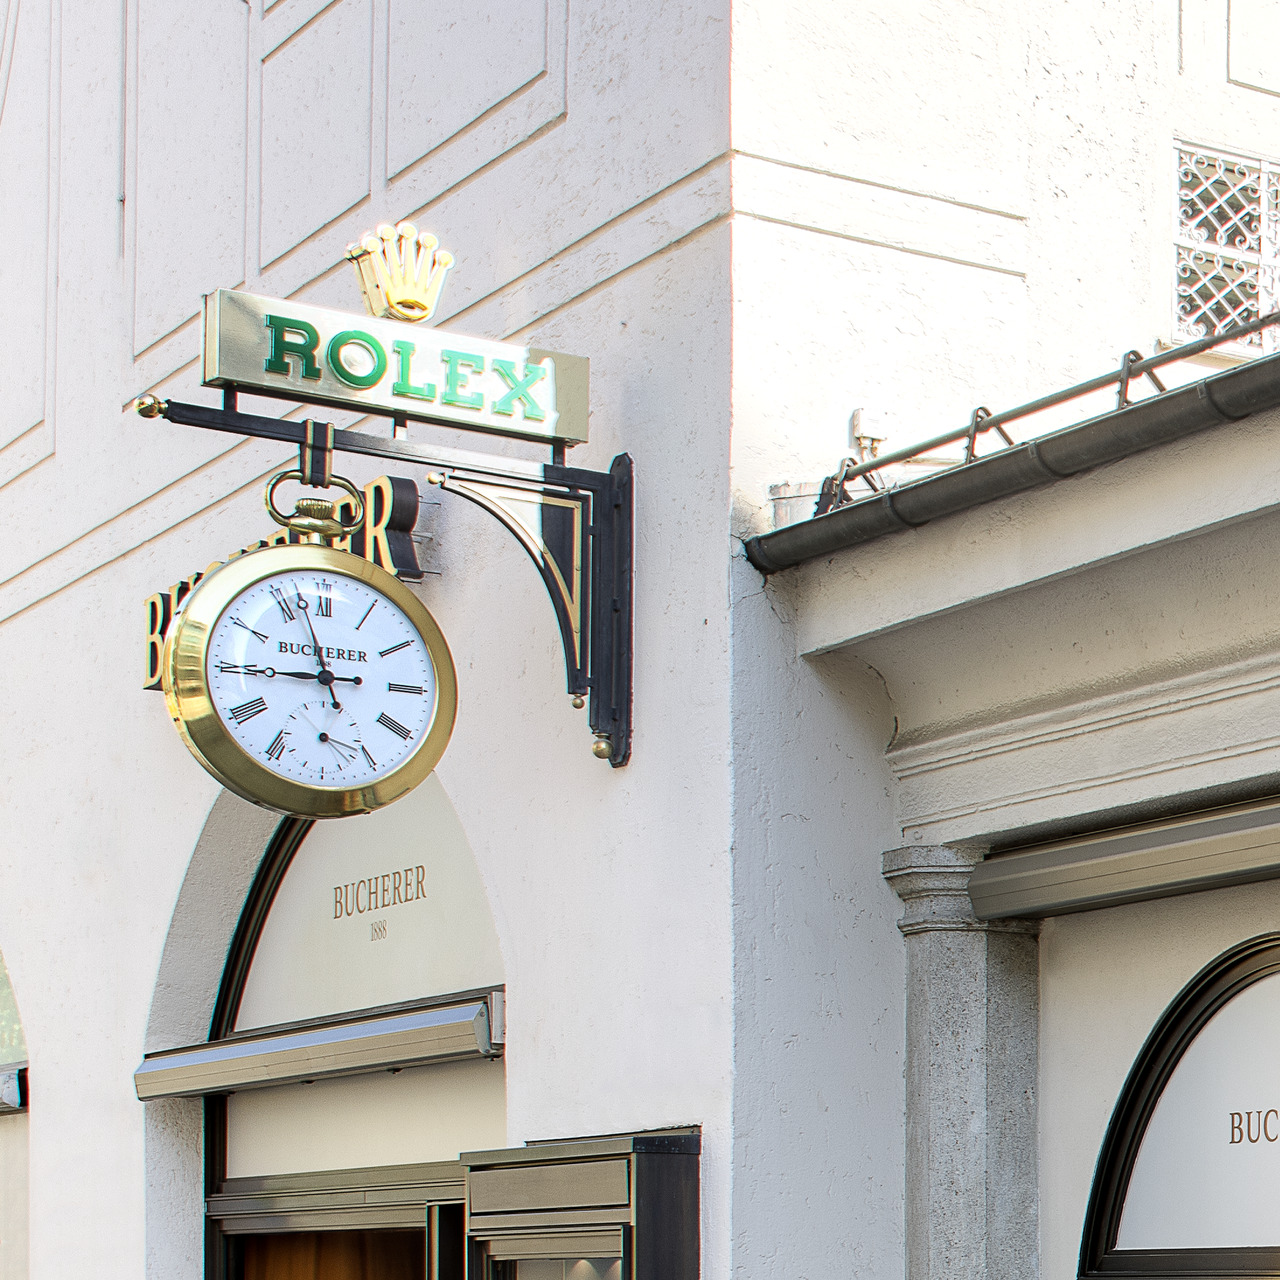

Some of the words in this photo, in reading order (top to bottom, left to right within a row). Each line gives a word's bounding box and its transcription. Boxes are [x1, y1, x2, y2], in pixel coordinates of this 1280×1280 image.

[264, 314, 547, 422] ROLEX
[333, 865, 427, 919] BUCHERER
[371, 920, 387, 941] 1888
